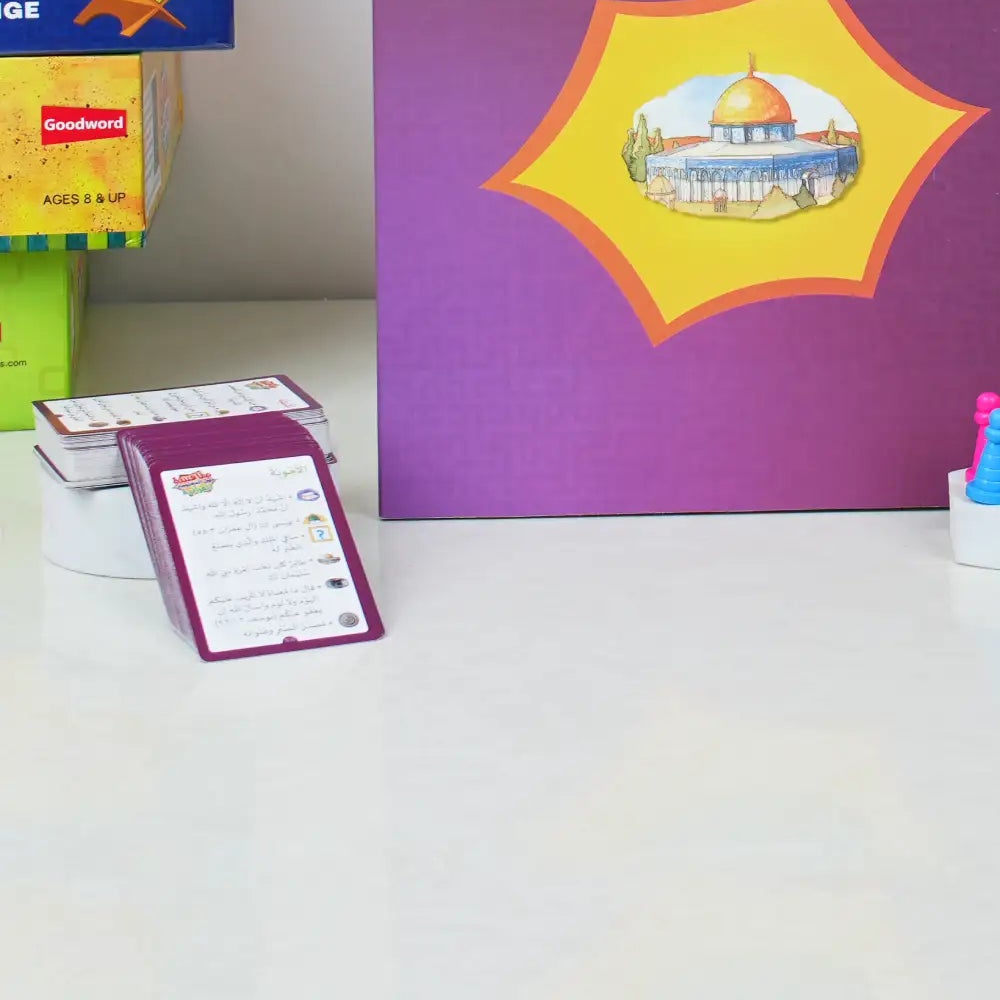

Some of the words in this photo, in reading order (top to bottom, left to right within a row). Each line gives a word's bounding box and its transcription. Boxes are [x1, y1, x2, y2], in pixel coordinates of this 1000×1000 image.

[0, 1, 40, 20] GE
[44, 116, 124, 131] Goodword
[43, 193, 80, 205] AGES
[83, 193, 92, 204] 8
[96, 192, 105, 204] &
[108, 192, 127, 203] UP
